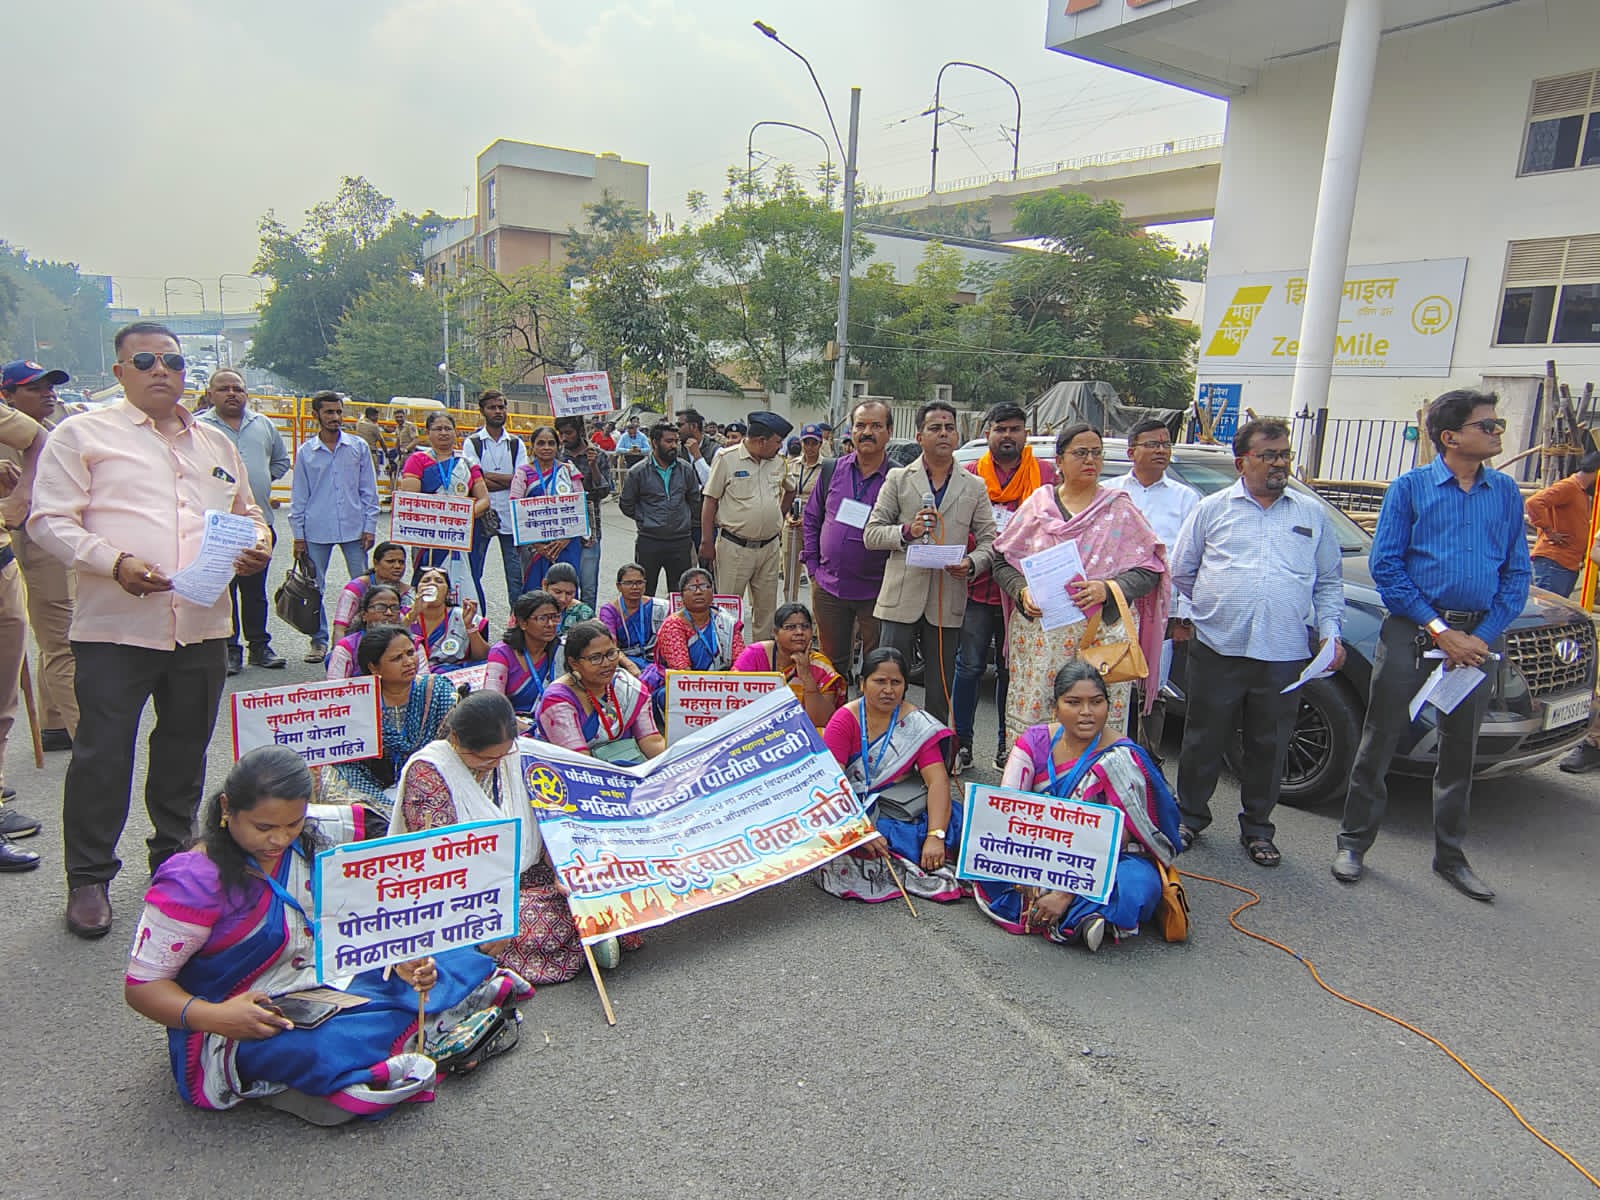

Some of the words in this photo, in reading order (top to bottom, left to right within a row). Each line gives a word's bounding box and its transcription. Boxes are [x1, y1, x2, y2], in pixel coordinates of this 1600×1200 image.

[1271, 337, 1300, 356] Ze
[1334, 333, 1389, 356] Mile
[1335, 358, 1360, 367] South
[1362, 358, 1387, 369] Entry
[448, 502, 470, 513] जागा
[439, 516, 468, 527] लवकर
[438, 527, 465, 543] पाहिजे
[677, 676, 740, 693] पोलीसांचा
[743, 682, 776, 694] पगार
[242, 692, 283, 710] पोलीस
[680, 697, 721, 715] महसुल
[266, 709, 314, 732] सुधारीत
[318, 704, 351, 720] नविन
[274, 730, 303, 745] विमा
[307, 725, 346, 740] योजना
[329, 738, 365, 757] पाहिजे
[565, 768, 604, 787] पोलीस
[578, 796, 632, 817] महिला
[988, 795, 1045, 821] महाराष्ट्र
[1050, 802, 1101, 829] पोलीस
[1008, 816, 1074, 848] जिंदाबाद
[342, 848, 426, 879] महाराष्ट्र
[432, 833, 498, 862] पोलीस
[560, 854, 653, 894] पोलीस
[750, 817, 807, 851] भव्य
[979, 832, 1053, 862] पोलीसांना
[1057, 851, 1097, 871] न्याय
[973, 854, 1043, 882] मिळालाच
[1047, 869, 1096, 892] पाहिजे
[376, 868, 468, 901] जिंदाबाद
[338, 900, 445, 938] पोलीसांना
[450, 888, 500, 911] न्याय
[335, 930, 435, 969] मिळालाच
[441, 909, 503, 942] पाहिजे
